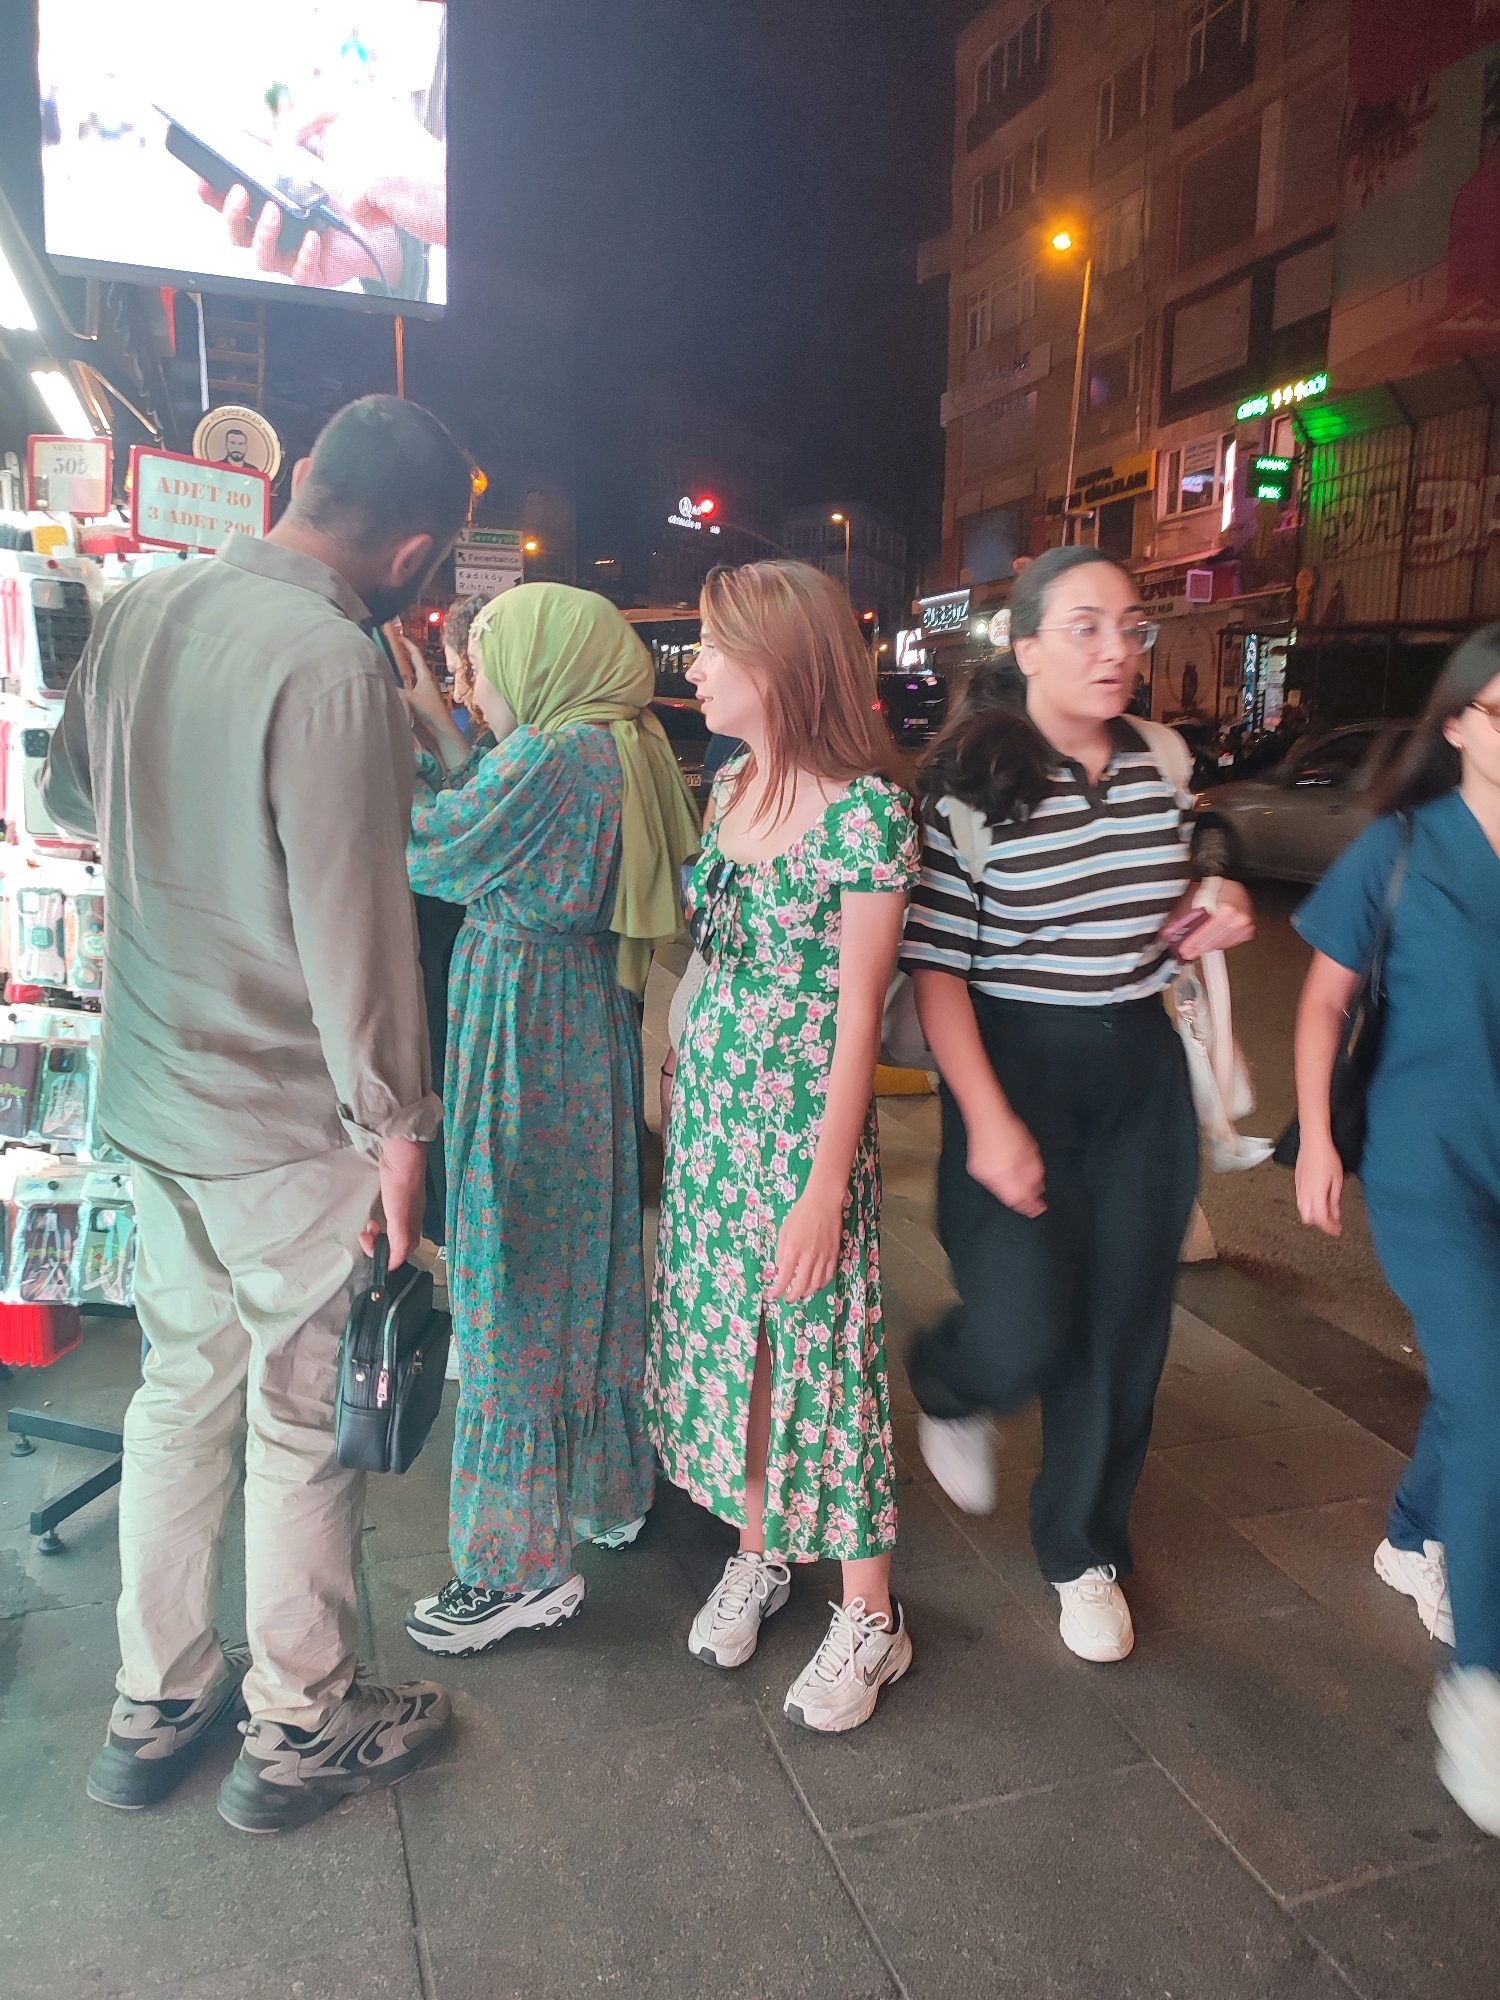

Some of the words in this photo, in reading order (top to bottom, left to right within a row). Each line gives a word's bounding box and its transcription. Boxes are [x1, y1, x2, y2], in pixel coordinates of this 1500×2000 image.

[156, 476, 221, 503] ADET
[226, 490, 252, 509] 80
[148, 505, 159, 520] 3
[167, 509, 218, 531] ADET
[459, 571, 503, 583] Kadıköy
